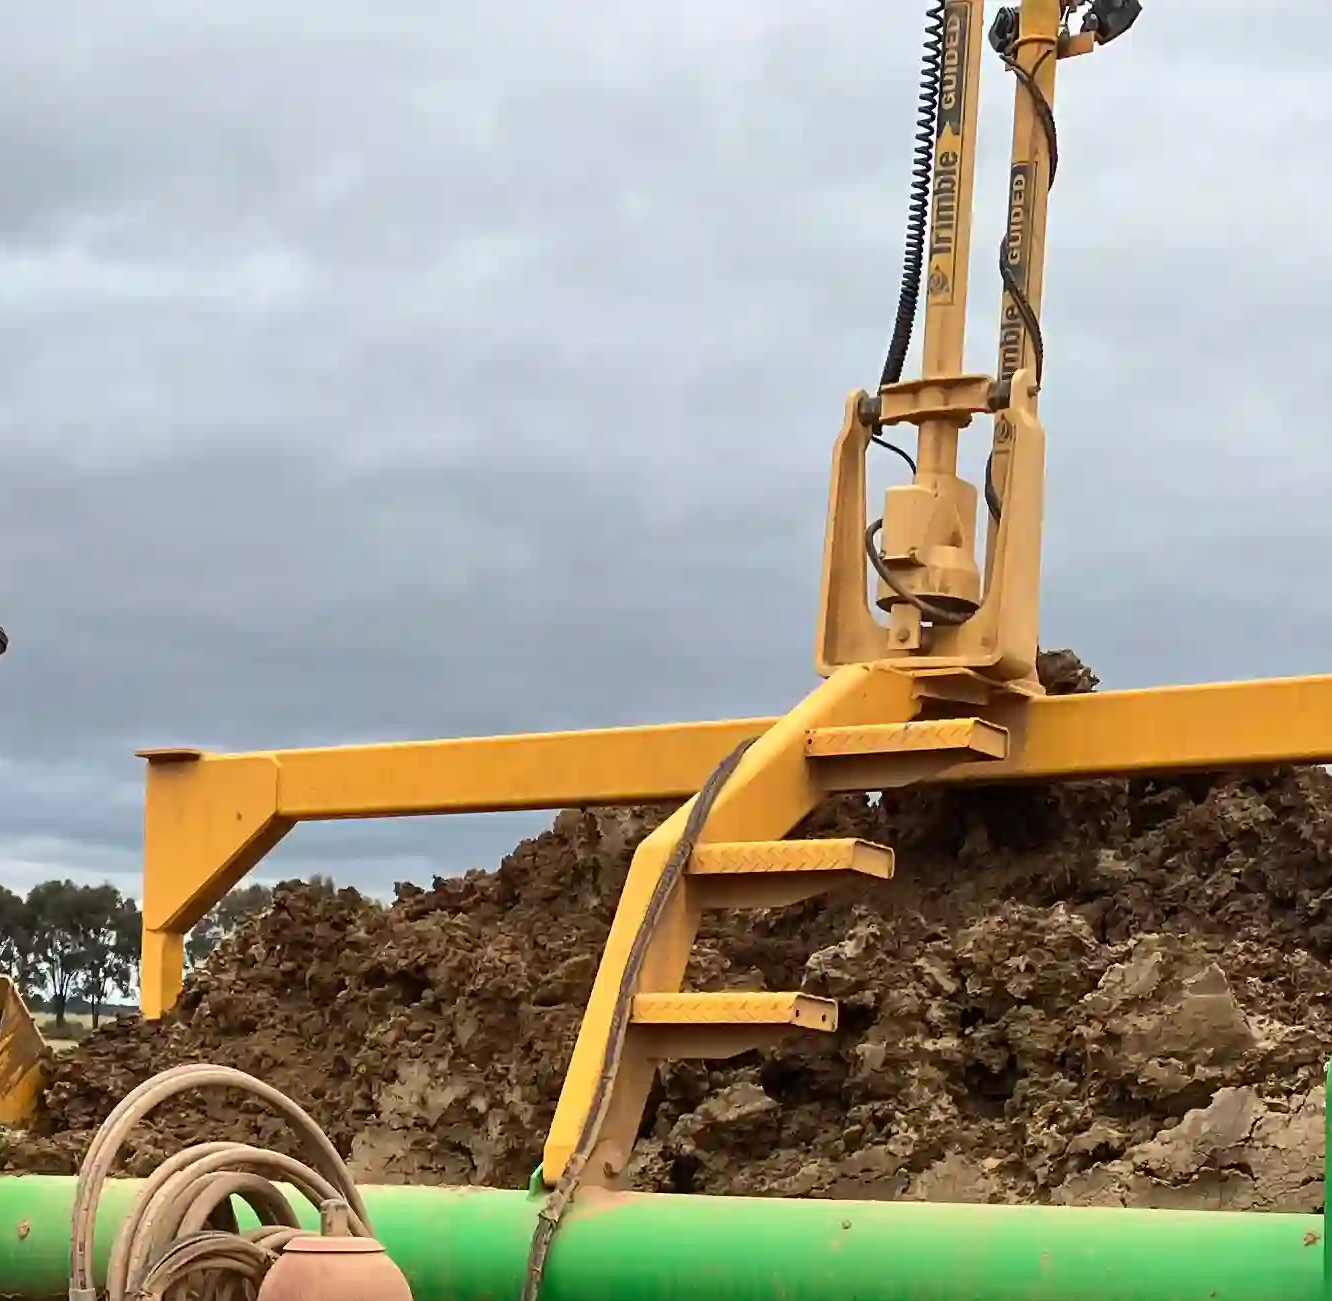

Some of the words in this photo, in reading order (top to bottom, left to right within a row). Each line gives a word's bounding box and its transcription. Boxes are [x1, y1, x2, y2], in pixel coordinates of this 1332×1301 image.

[941, 15, 961, 110] GUIDED
[932, 150, 958, 256] Trimble
[1008, 173, 1025, 266] GUIDED
[1000, 304, 1020, 380] imble
